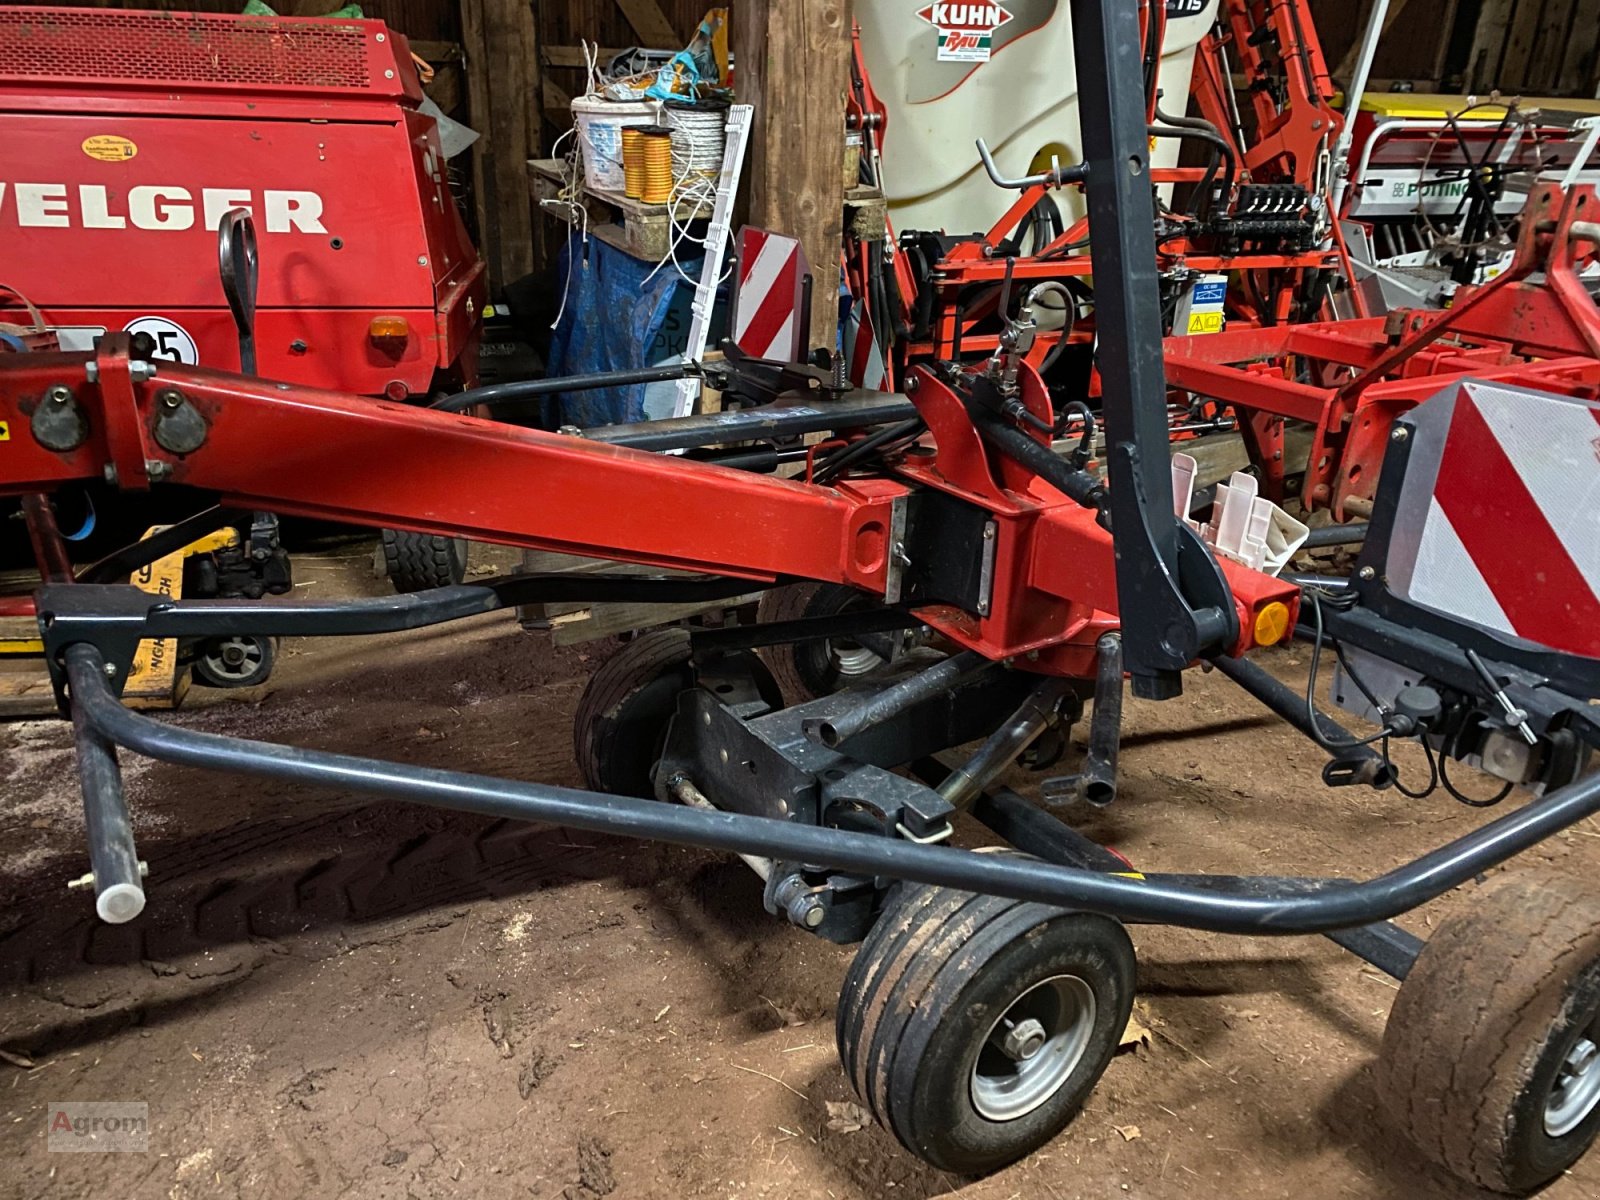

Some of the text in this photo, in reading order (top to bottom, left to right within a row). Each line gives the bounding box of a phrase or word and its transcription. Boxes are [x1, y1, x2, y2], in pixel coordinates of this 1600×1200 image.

[931, 4, 1001, 26] KUHN
[945, 31, 979, 52] RAU
[0, 182, 328, 234] ELGER
